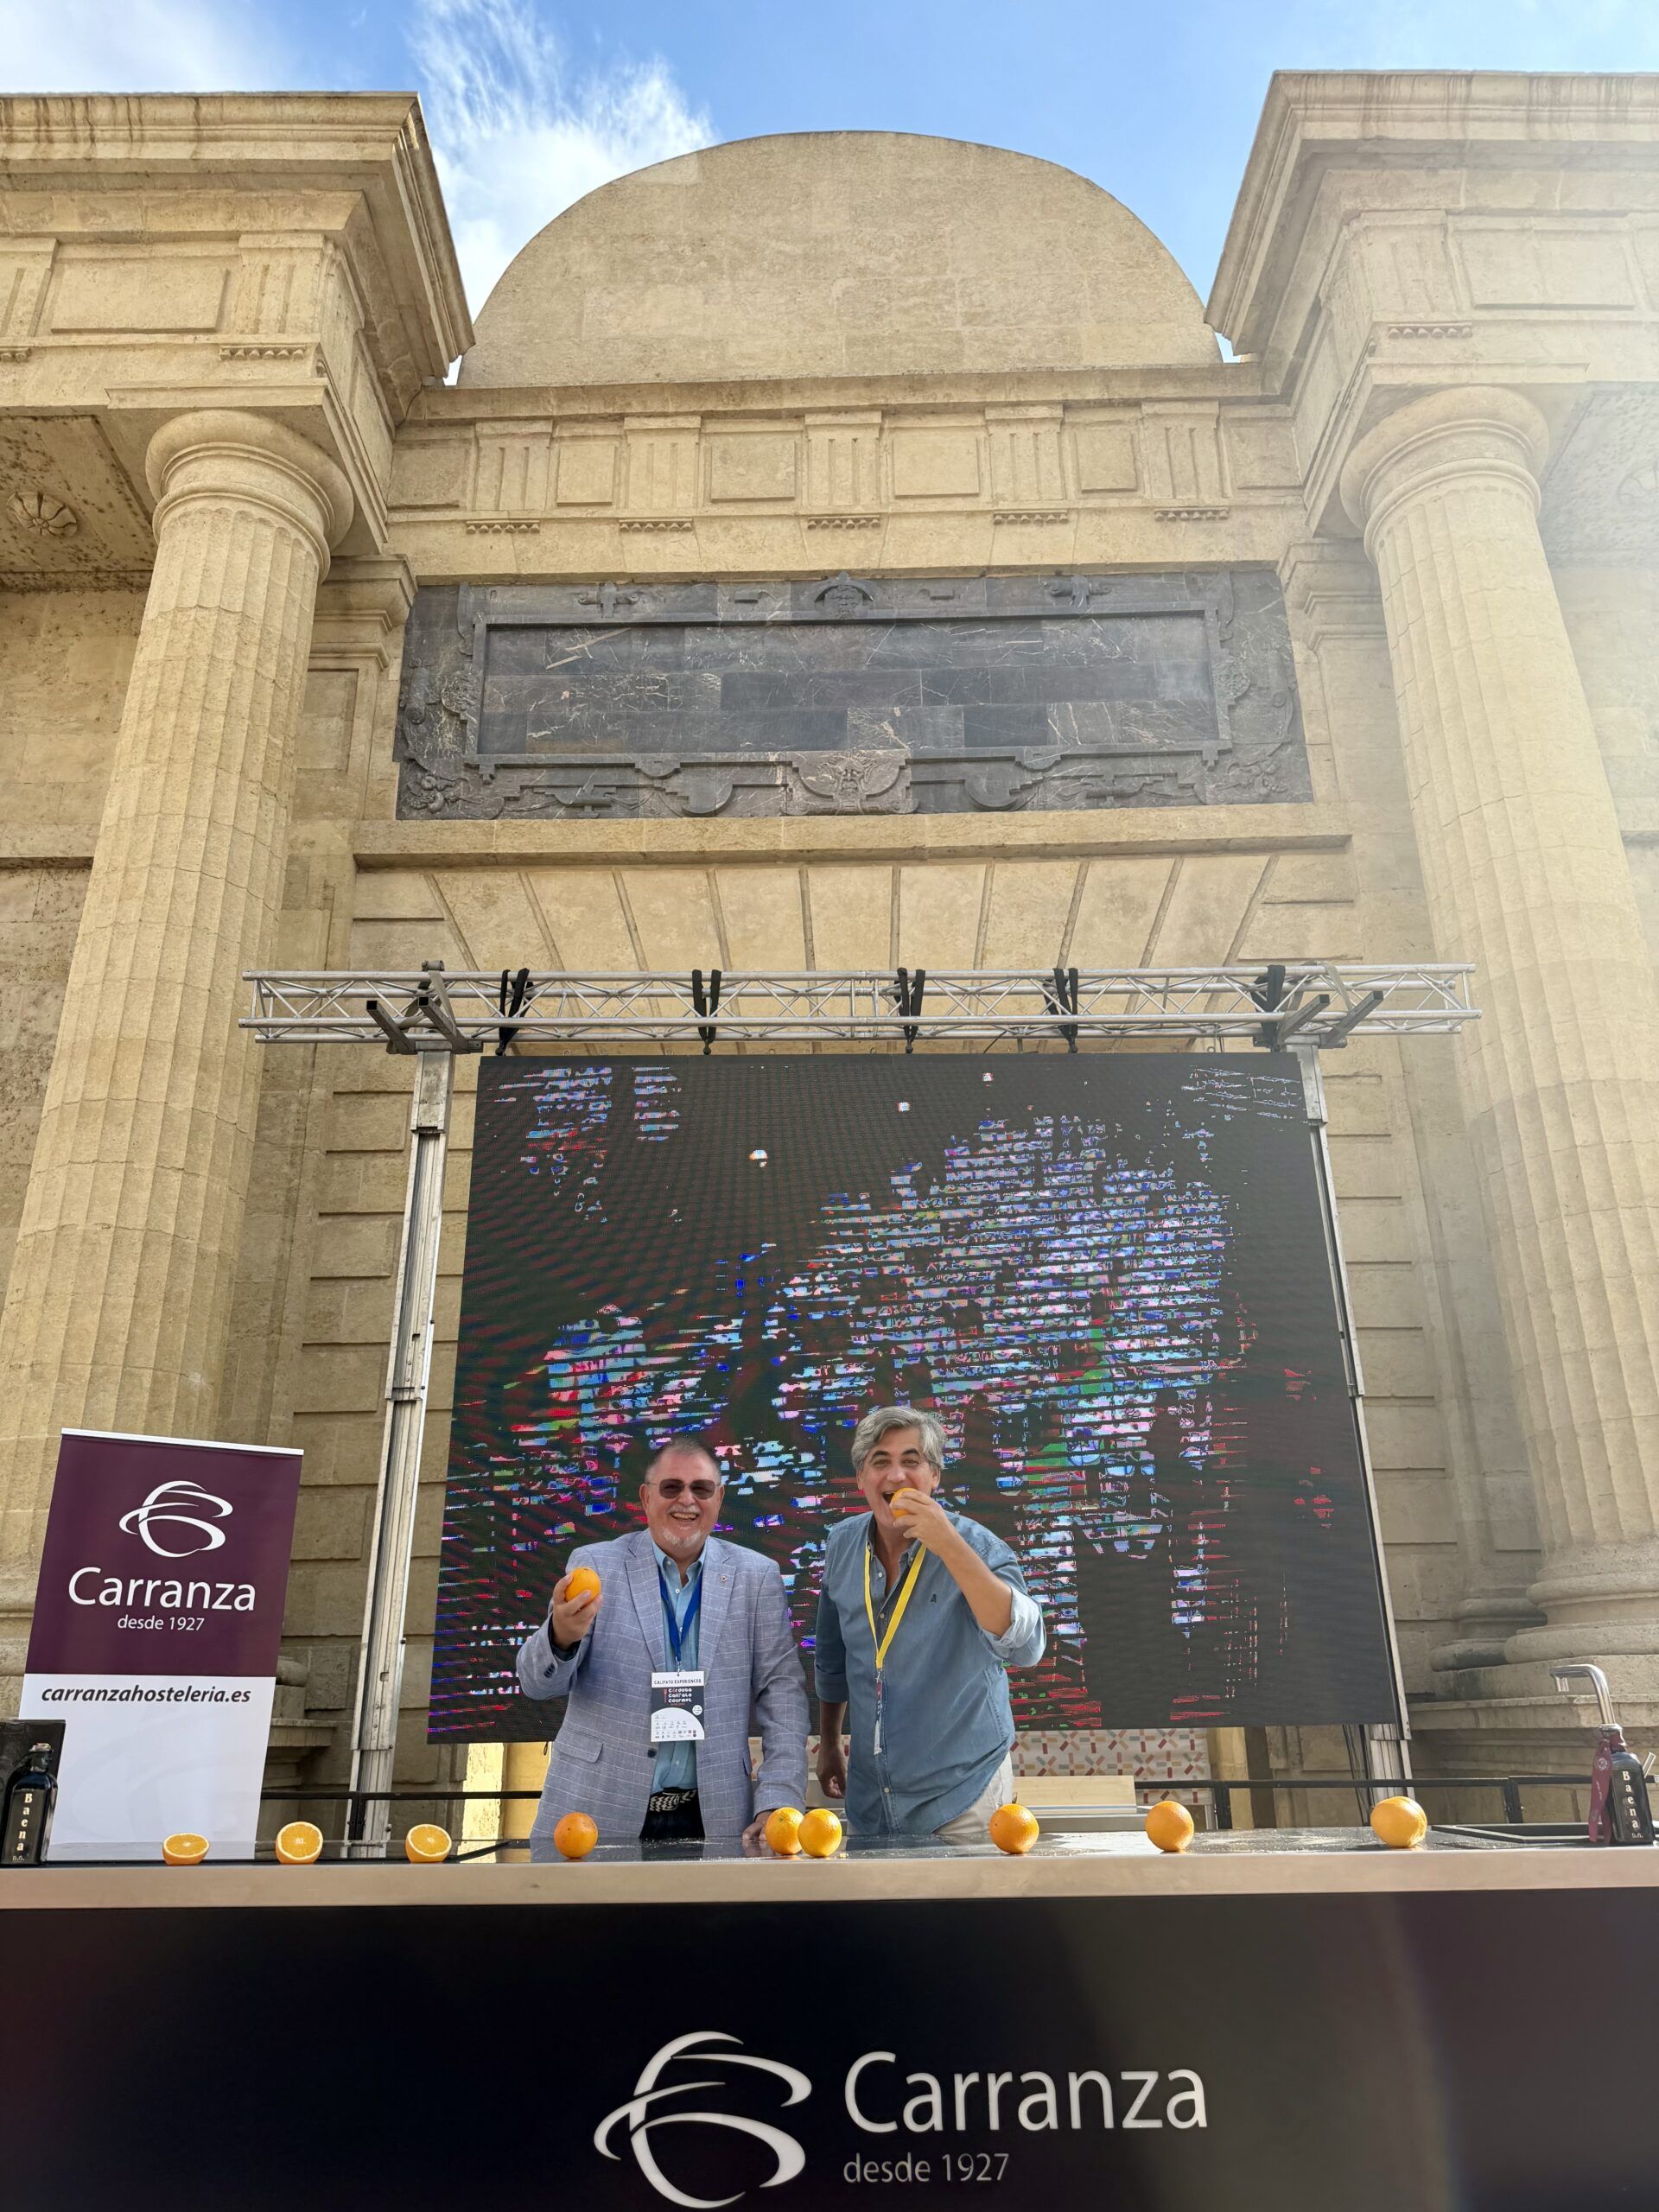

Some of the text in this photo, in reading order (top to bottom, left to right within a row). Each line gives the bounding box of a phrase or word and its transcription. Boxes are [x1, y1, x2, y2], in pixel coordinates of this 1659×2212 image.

[69, 1567, 255, 1611] Carranza
[118, 1615, 204, 1630] desde 1927
[42, 1685, 251, 1702] carranzahosteleria.es
[1622, 1770, 1639, 1829] Baena
[16, 1793, 33, 1852] Baena
[845, 2052, 1207, 2133] Carranza
[844, 2152, 1008, 2183] desde 1927
